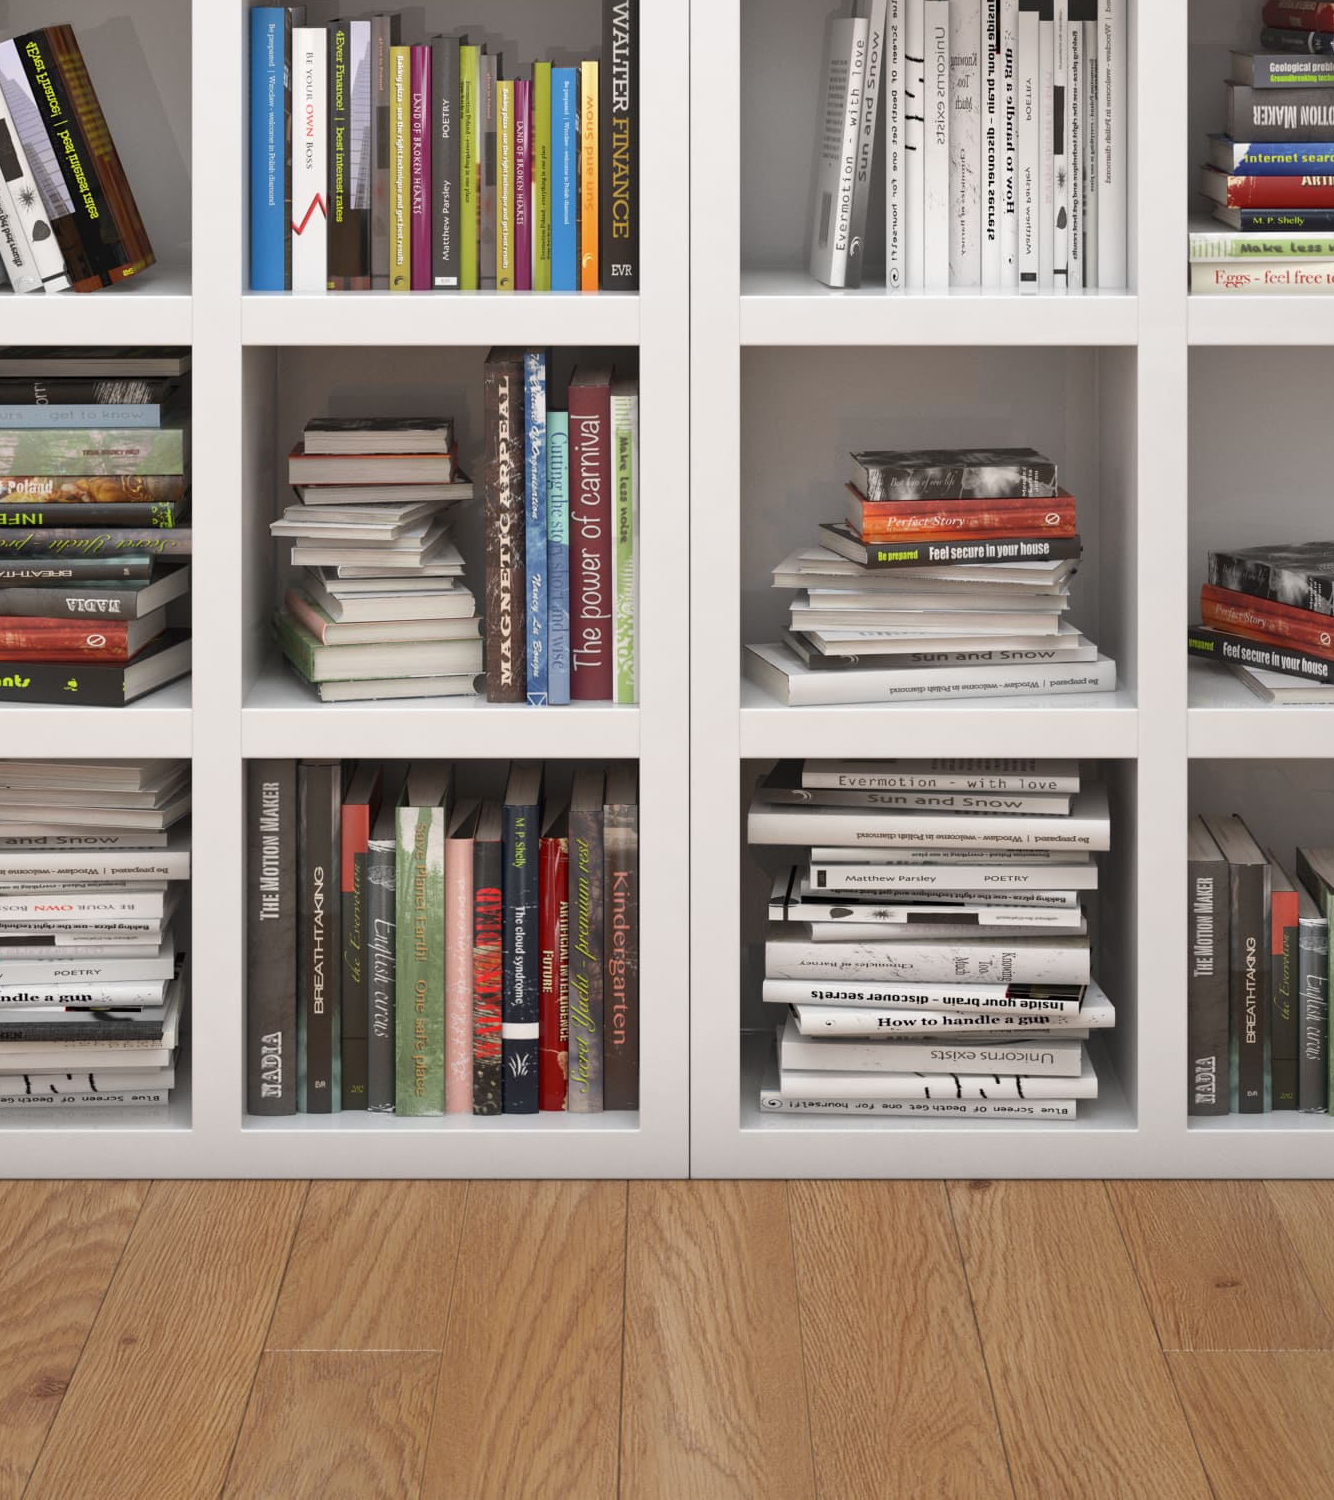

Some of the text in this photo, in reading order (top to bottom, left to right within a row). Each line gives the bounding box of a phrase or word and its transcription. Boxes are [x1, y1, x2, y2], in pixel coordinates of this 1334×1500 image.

[306, 52, 313, 64] BE
[1269, 62, 1311, 73] Geological
[335, 31, 345, 223] 4Ever Finance! best interest rates
[613, 0, 629, 237] WALTER FINANCE
[1244, 153, 1298, 163] Internet
[1278, 216, 1304, 225] Shelly
[1241, 244, 1283, 254] Make
[1291, 243, 1322, 253] less
[612, 264, 631, 276] EVR
[571, 415, 610, 670] The power of carnival
[929, 542, 1049, 560] Feel secure in your house
[500, 513, 512, 685] MAGNETIC
[314, 866, 323, 1014] BREATHTAKING
[608, 871, 629, 1044] Kindergarten
[878, 1017, 917, 1027] How
[921, 1017, 938, 1026] to
[943, 1014, 1000, 1026] handle
[1018, 1015, 1051, 1026] gun
[262, 1032, 281, 1098] NADIA
